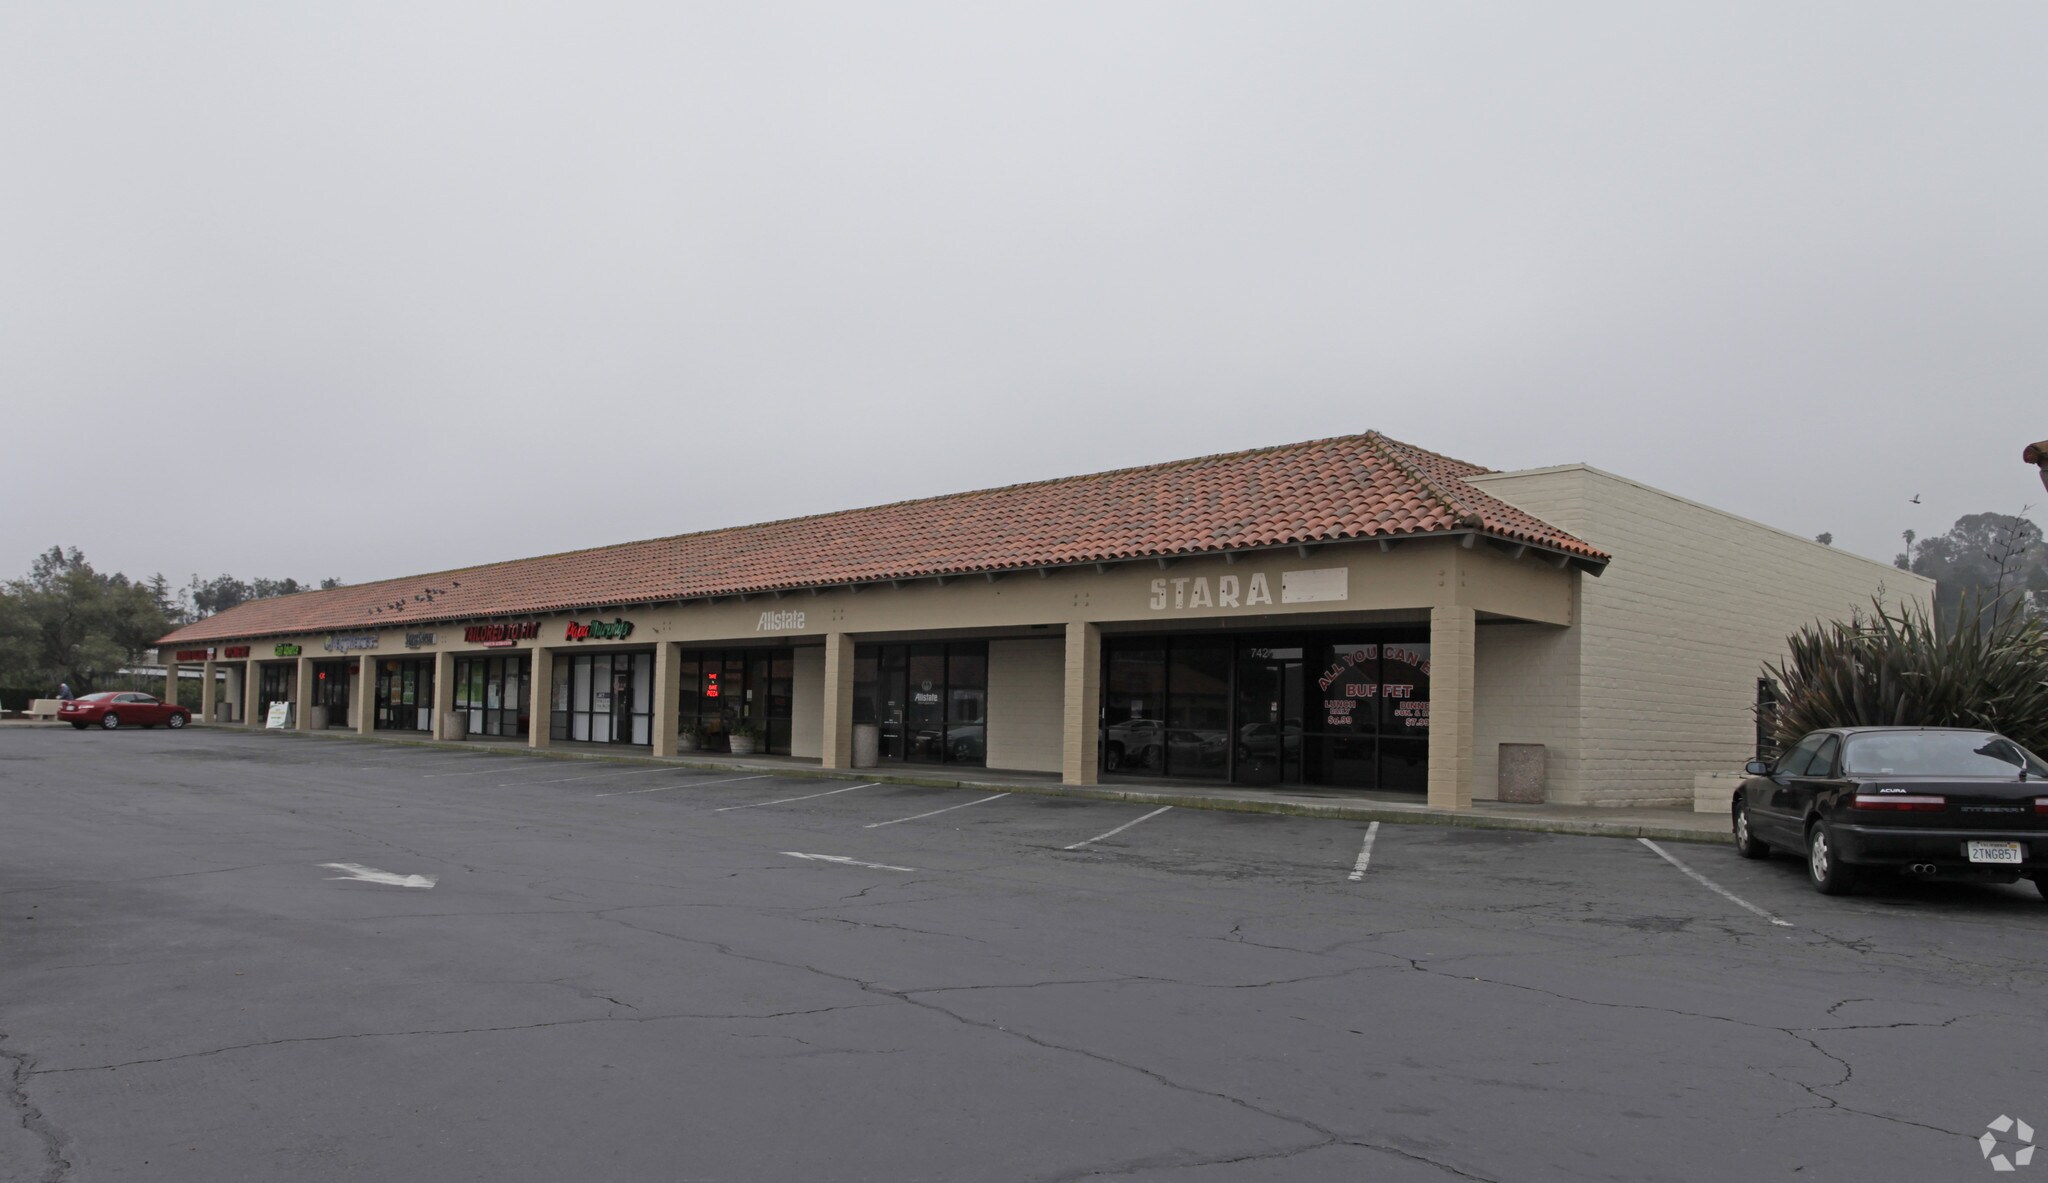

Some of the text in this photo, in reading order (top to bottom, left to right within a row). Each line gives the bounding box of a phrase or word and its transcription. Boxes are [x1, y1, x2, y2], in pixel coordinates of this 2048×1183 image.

[1150, 572, 1273, 610] STARA
[565, 620, 589, 640] Papa
[756, 610, 805, 631] Allstate
[463, 621, 540, 642] TAILORED TO FIT
[1318, 646, 1420, 691] ALL YOU CAN
[914, 693, 938, 702] Allstate
[1324, 700, 1357, 709] LUNCH
[1400, 701, 1430, 710] DINNE
[1972, 848, 2017, 860] 2TNG857
